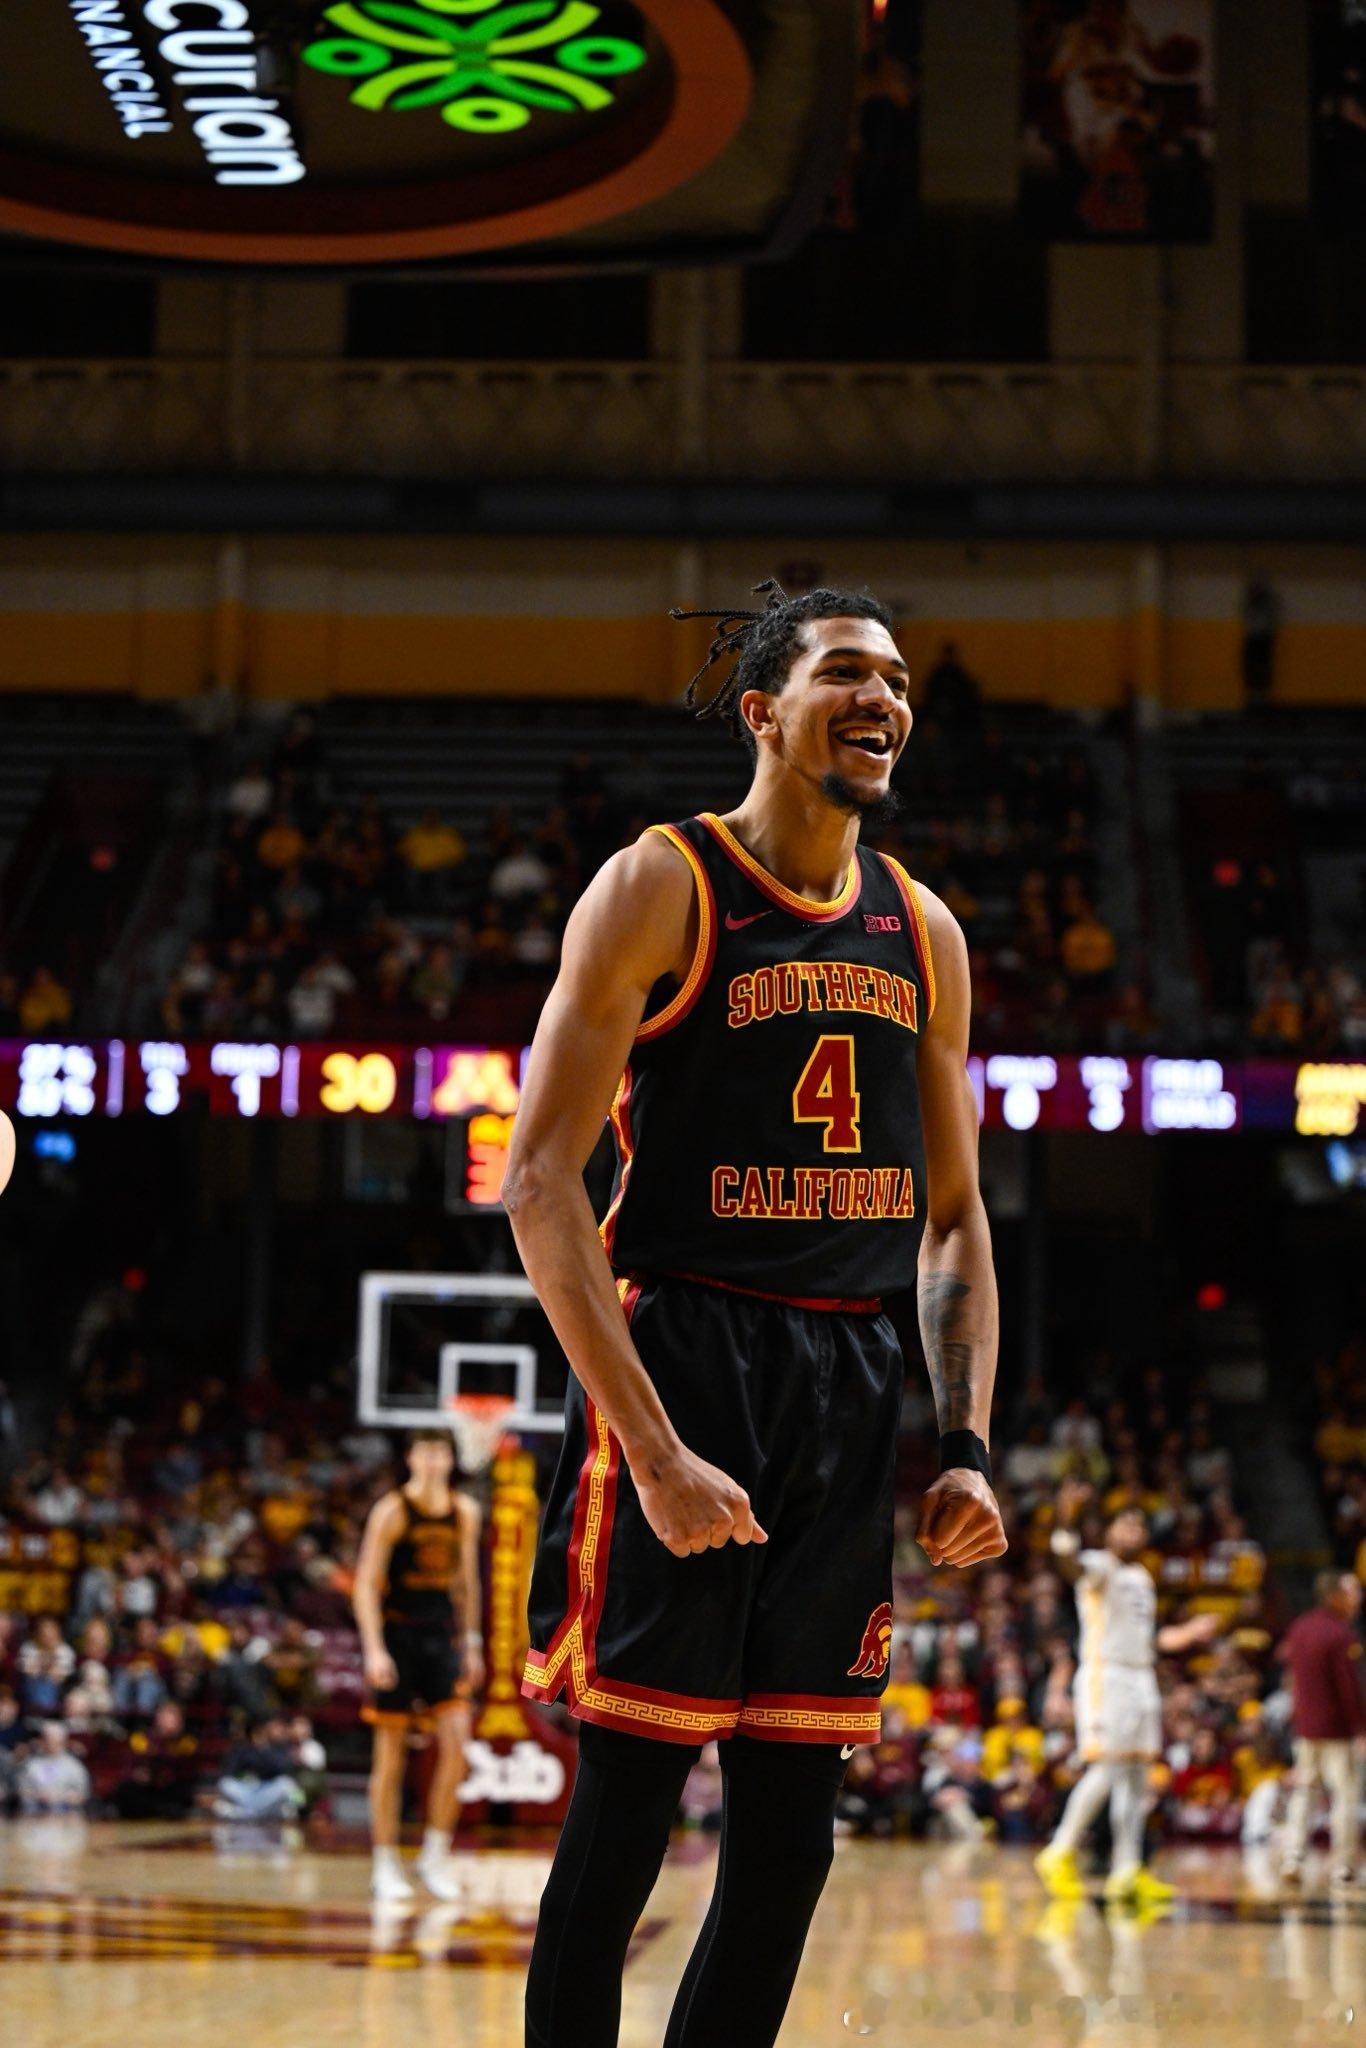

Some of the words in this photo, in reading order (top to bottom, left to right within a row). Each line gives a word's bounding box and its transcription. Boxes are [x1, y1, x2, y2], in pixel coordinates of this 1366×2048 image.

[728, 961, 918, 1034] SOUTHERN
[321, 1052, 396, 1113] 30
[793, 1034, 861, 1153] 4
[712, 1165, 915, 1219] CALIFORNIA
